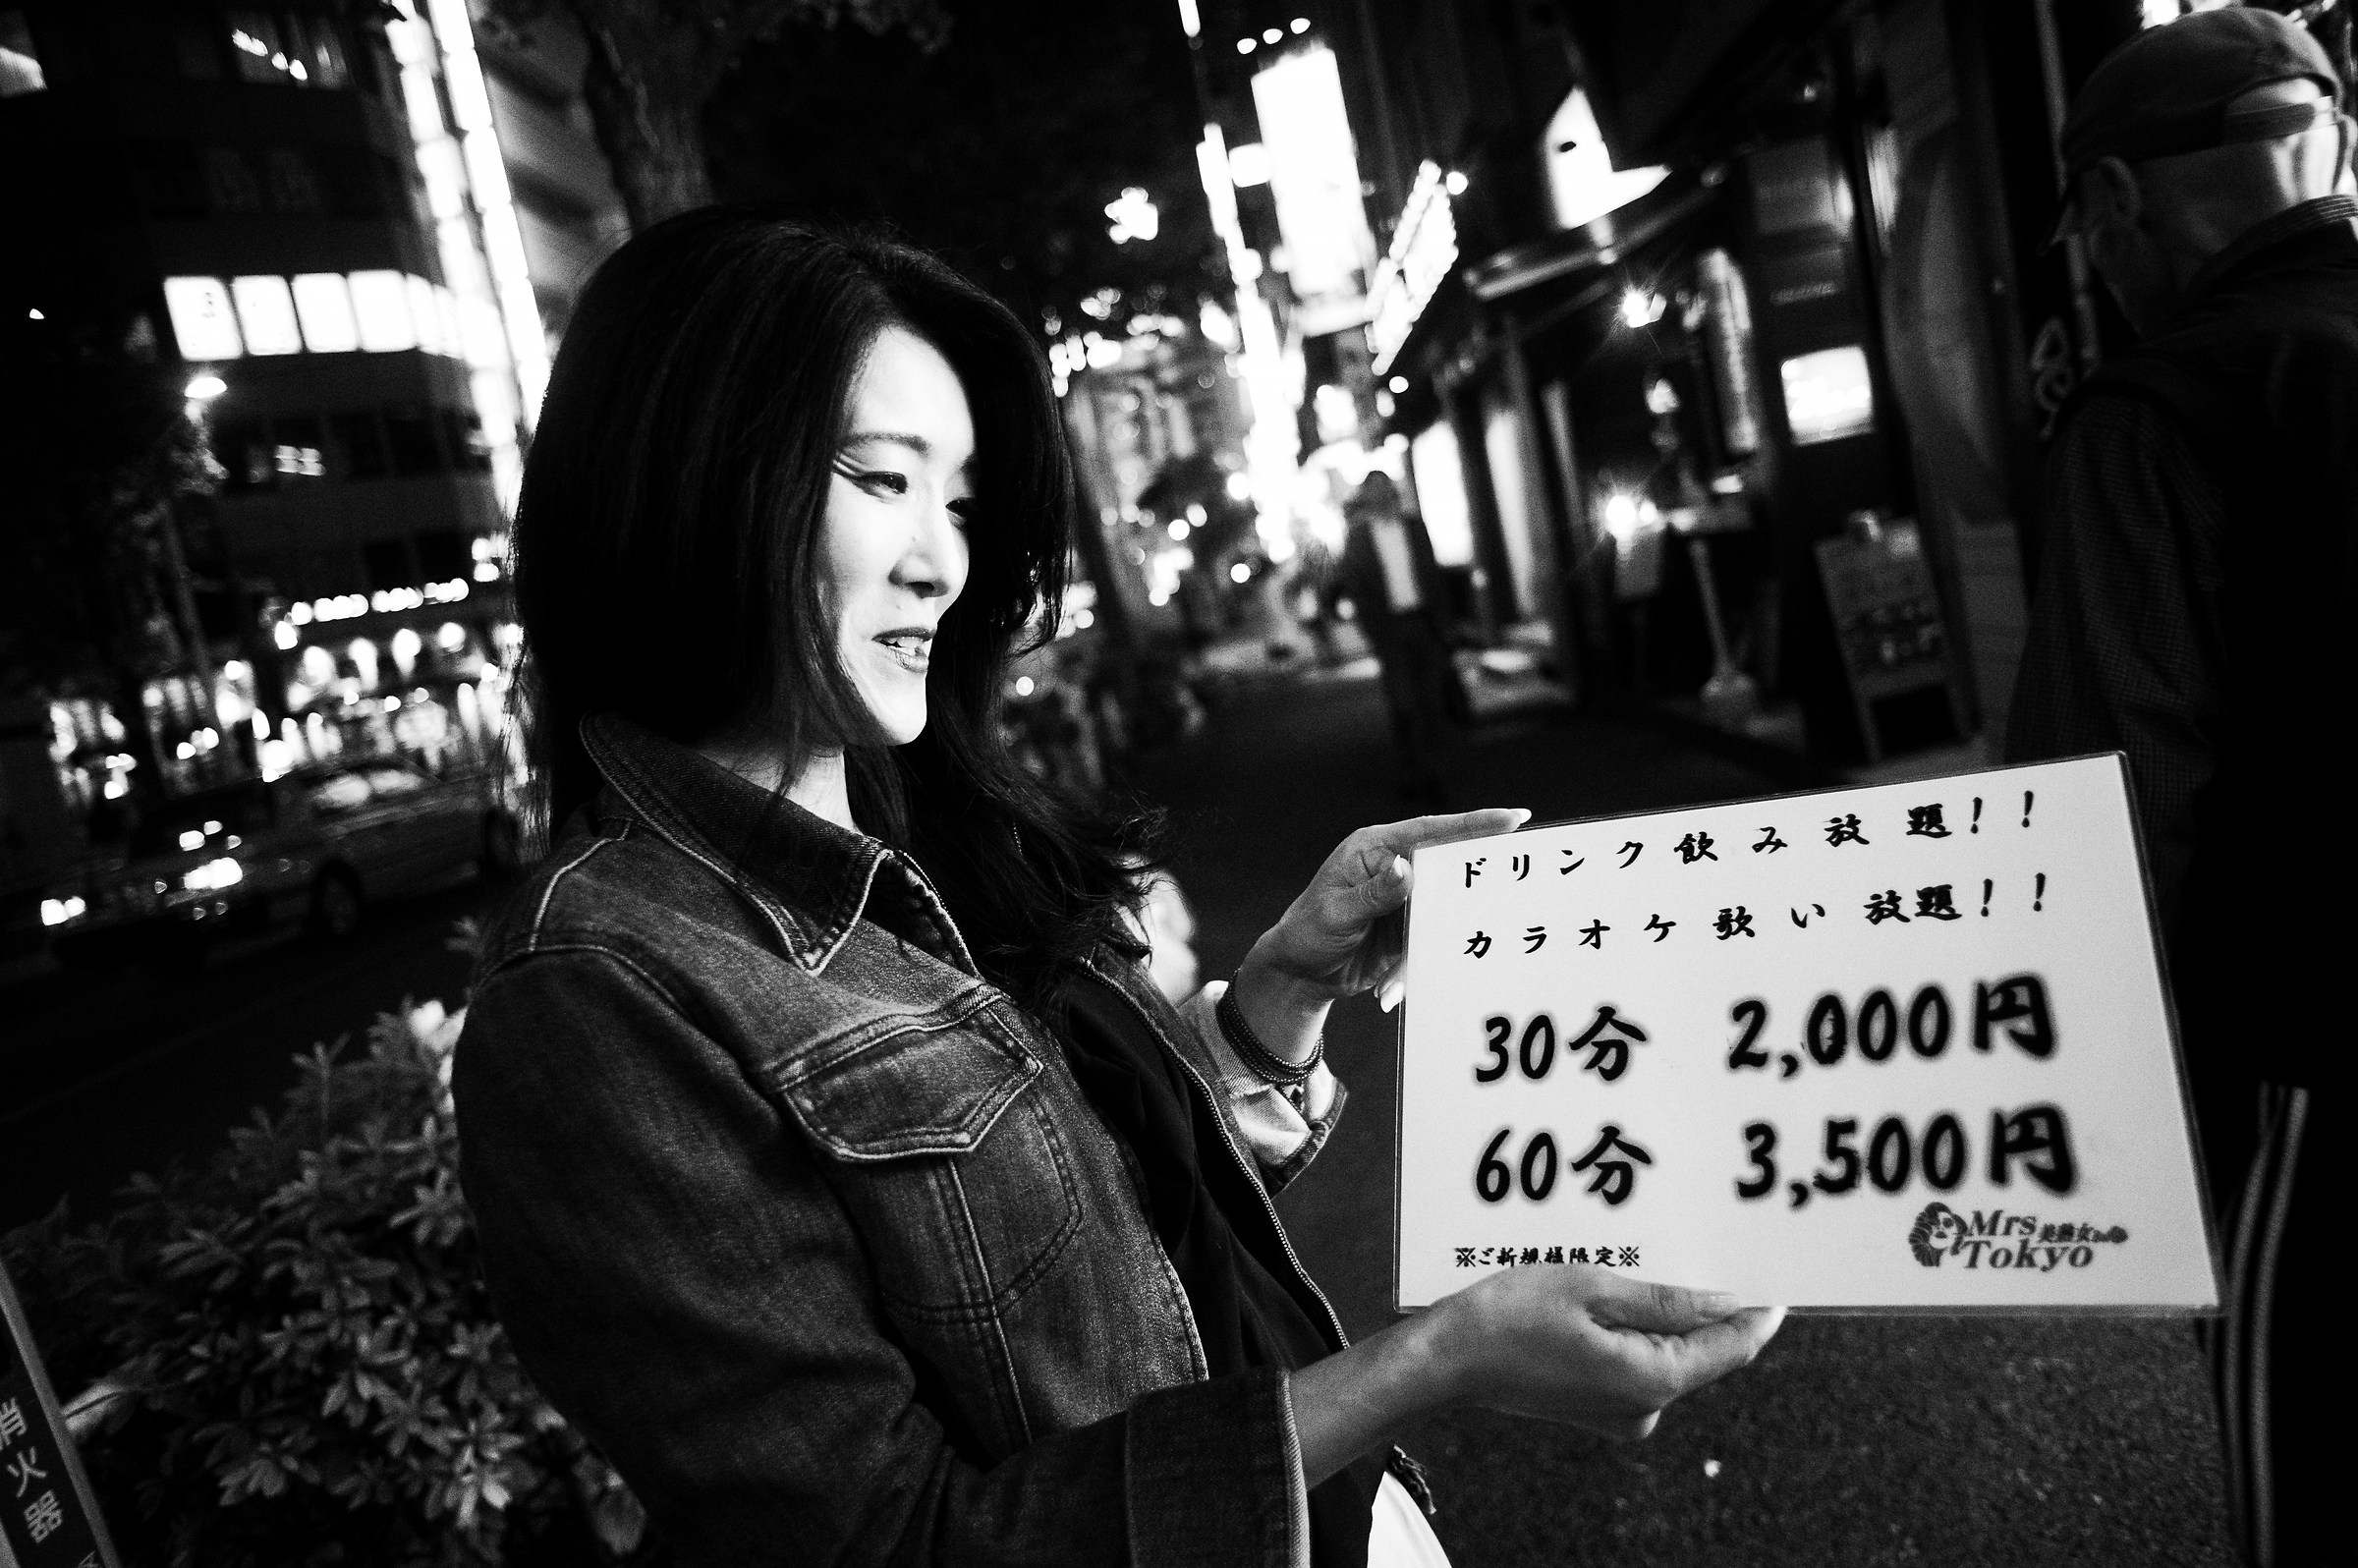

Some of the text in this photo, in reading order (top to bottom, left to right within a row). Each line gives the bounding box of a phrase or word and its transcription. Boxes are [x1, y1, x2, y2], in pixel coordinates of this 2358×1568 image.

[1464, 789, 2034, 889] ドリンク飲み放題!!
[1463, 872, 2046, 960] カラオケ歌い放題!!
[1473, 972, 2060, 1084] 30分 2,000円
[1474, 1102, 2080, 1208] 60分 3,500円
[1962, 1238, 2095, 1272] Tokyo
[1964, 1209, 2037, 1237] Mrs
